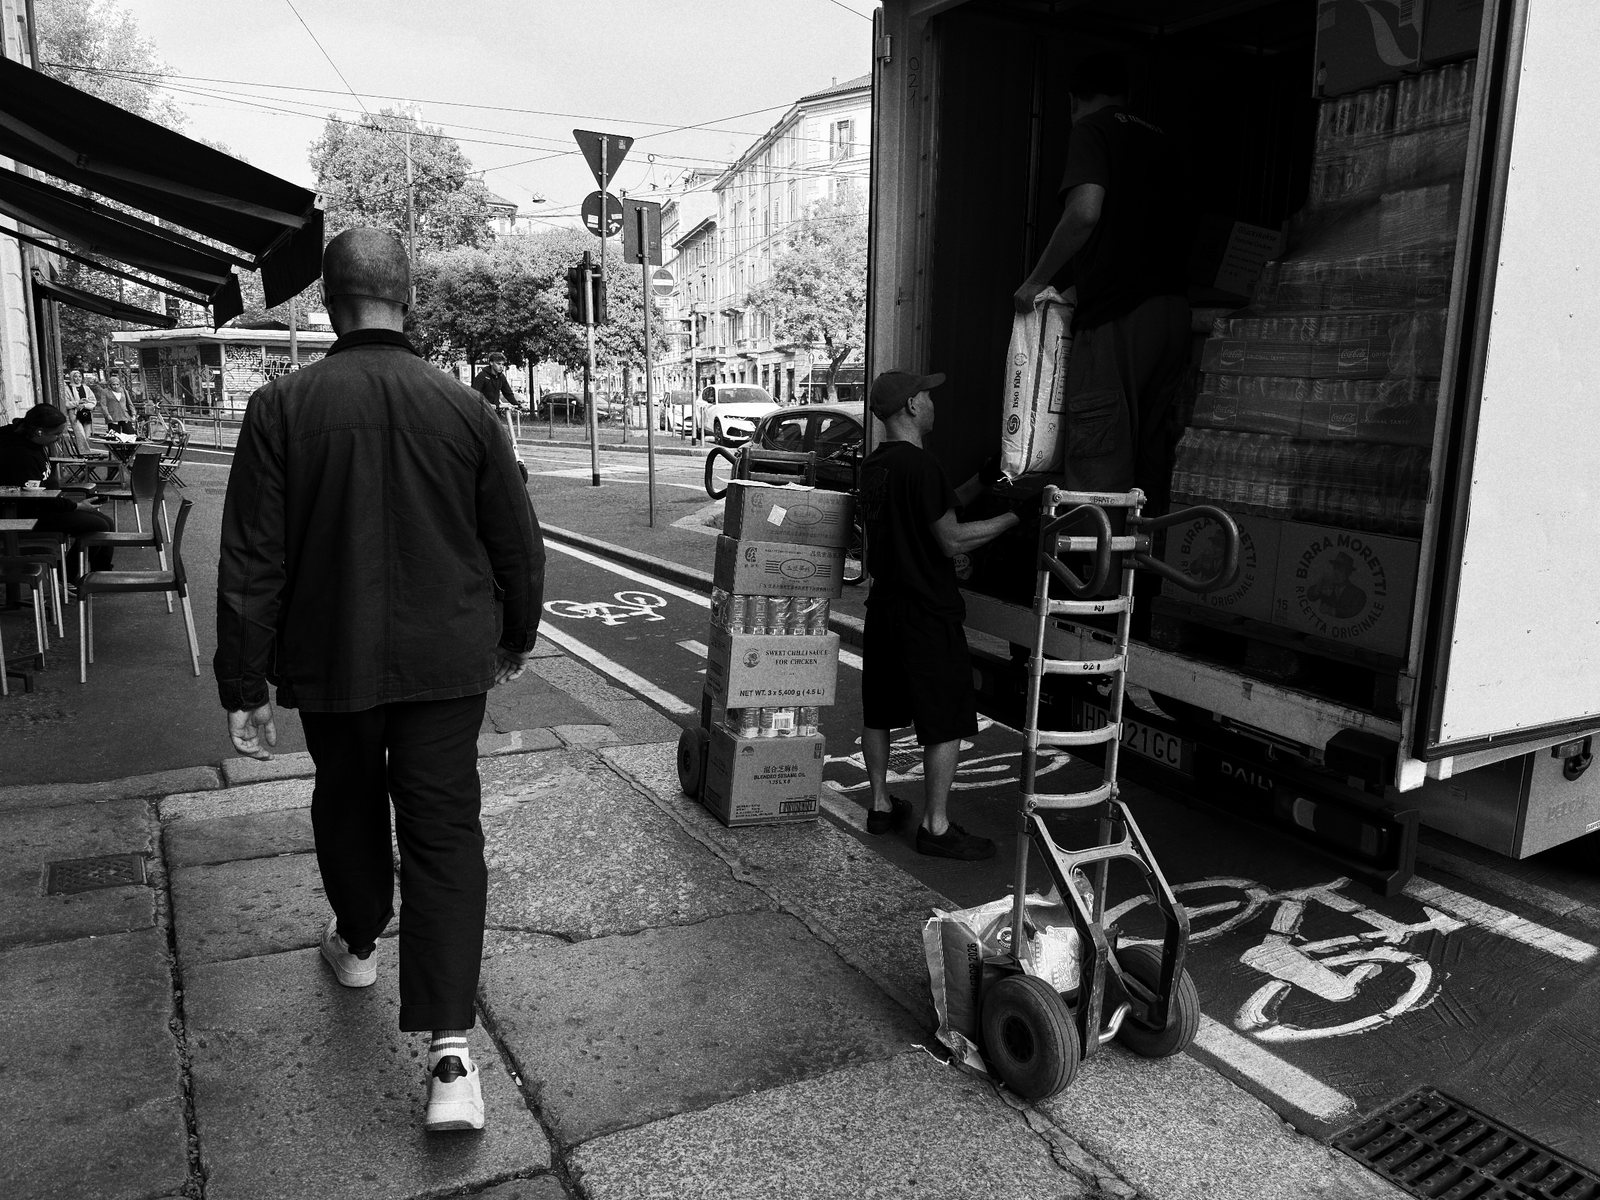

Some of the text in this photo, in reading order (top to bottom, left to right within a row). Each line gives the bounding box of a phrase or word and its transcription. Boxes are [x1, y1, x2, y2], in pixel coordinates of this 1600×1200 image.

[908, 56, 920, 109] 021
[1295, 533, 1388, 597] BIRRA MORETTI
[1211, 573, 1255, 607] ORIGINALE
[1295, 585, 1386, 639] RICETTA ORIGINALE
[778, 689, 795, 697] 5,400
[1086, 703, 1107, 730] HD
[967, 942, 979, 962] 2026
[969, 963, 980, 986] CROP
